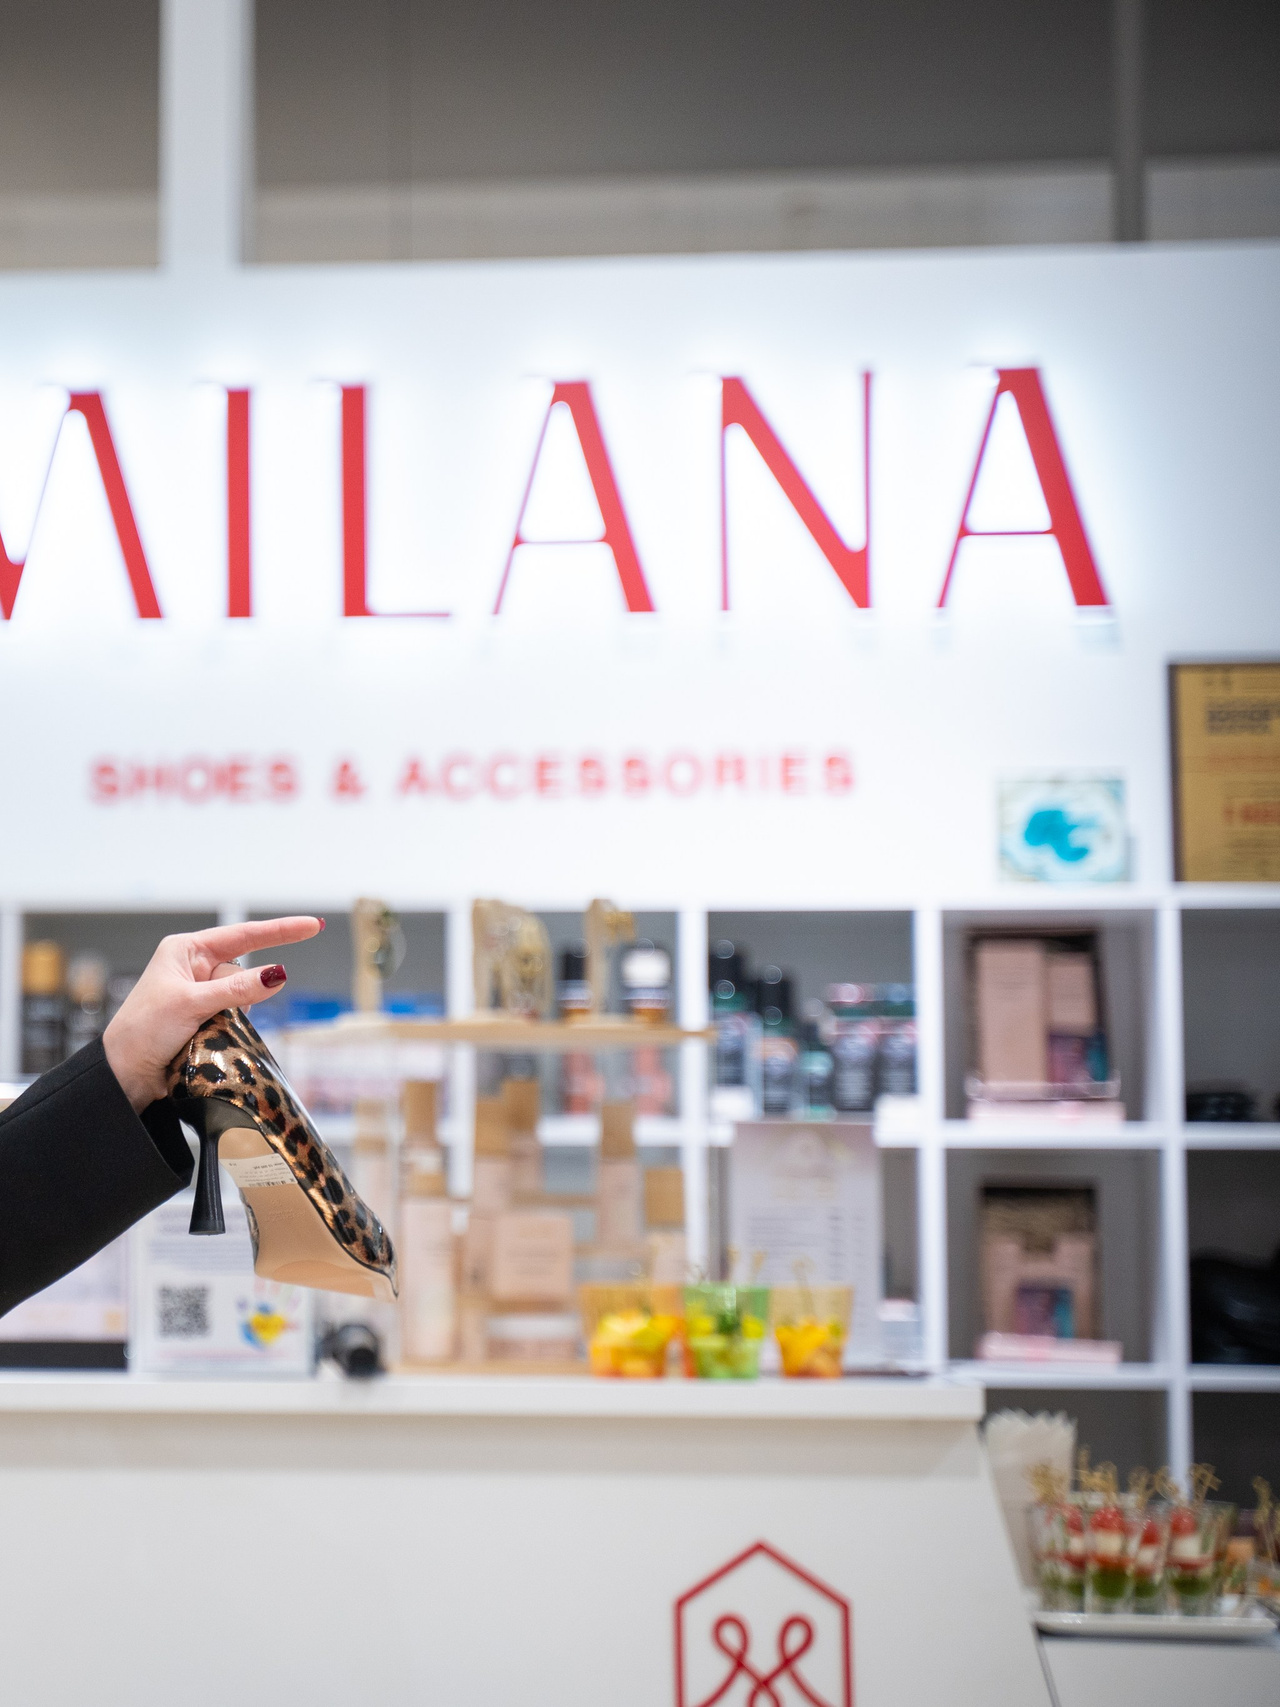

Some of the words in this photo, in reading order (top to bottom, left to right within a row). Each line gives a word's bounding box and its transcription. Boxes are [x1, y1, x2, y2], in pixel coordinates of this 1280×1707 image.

[92, 756, 297, 802] SHOES
[333, 759, 368, 801] &
[397, 751, 855, 801] ACCESSORIES
